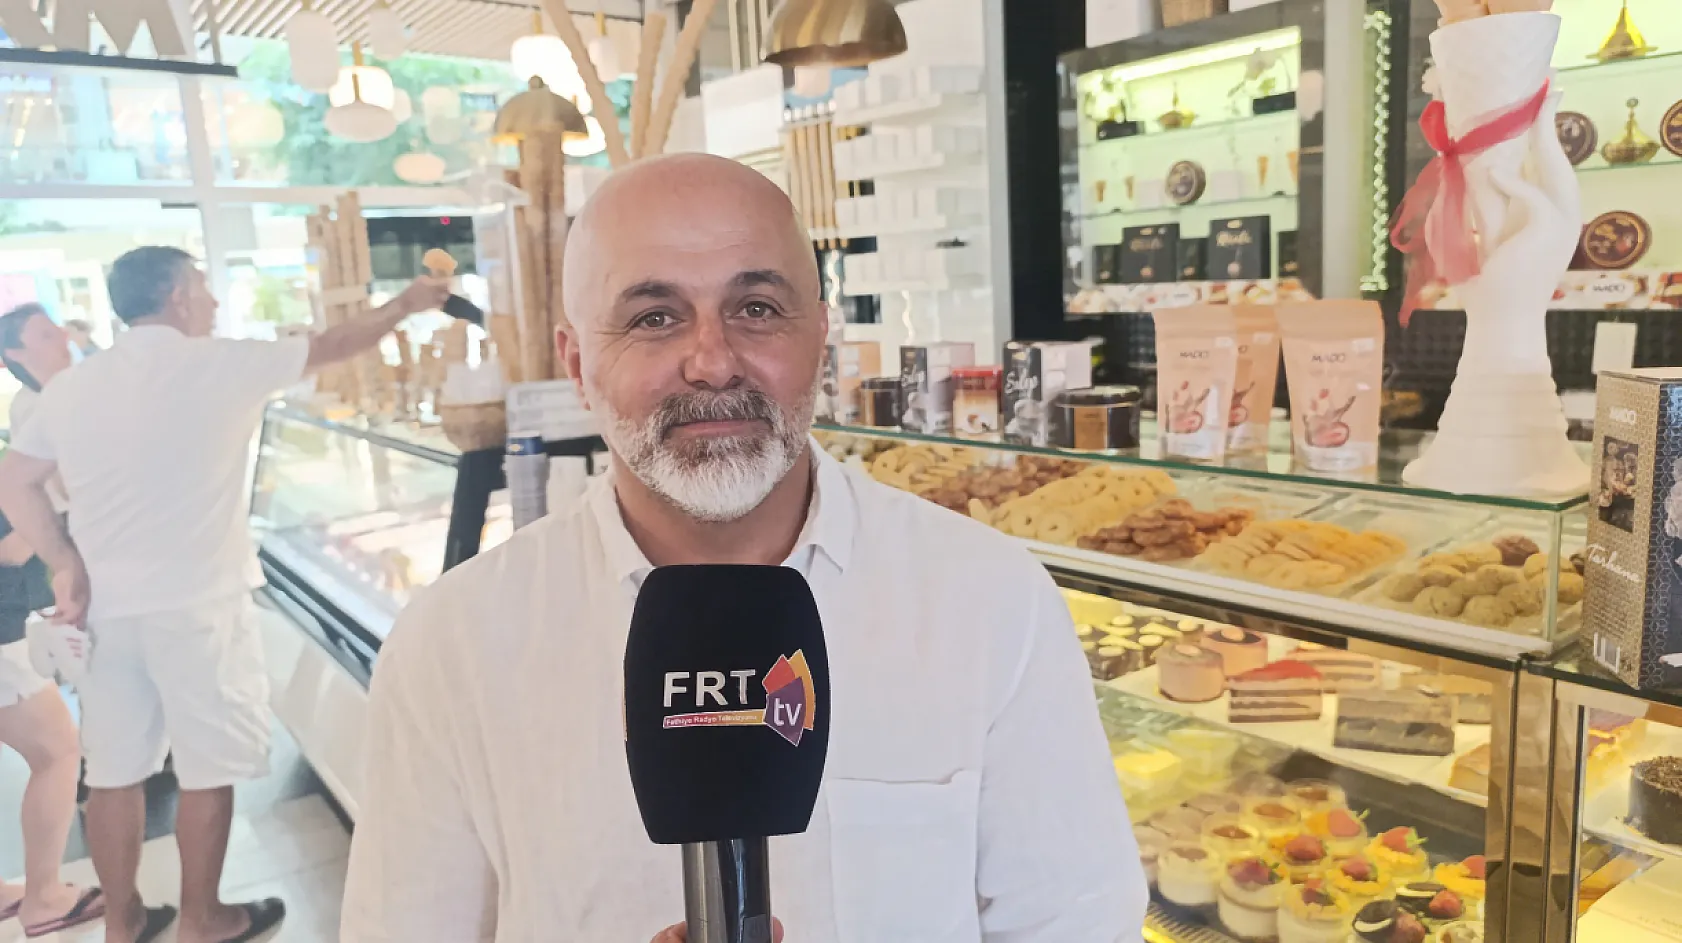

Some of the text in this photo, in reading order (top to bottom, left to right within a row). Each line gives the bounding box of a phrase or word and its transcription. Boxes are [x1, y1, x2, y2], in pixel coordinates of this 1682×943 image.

[663, 668, 756, 707] FRT
[694, 714, 718, 725] Radyo
[773, 697, 803, 727] tv
